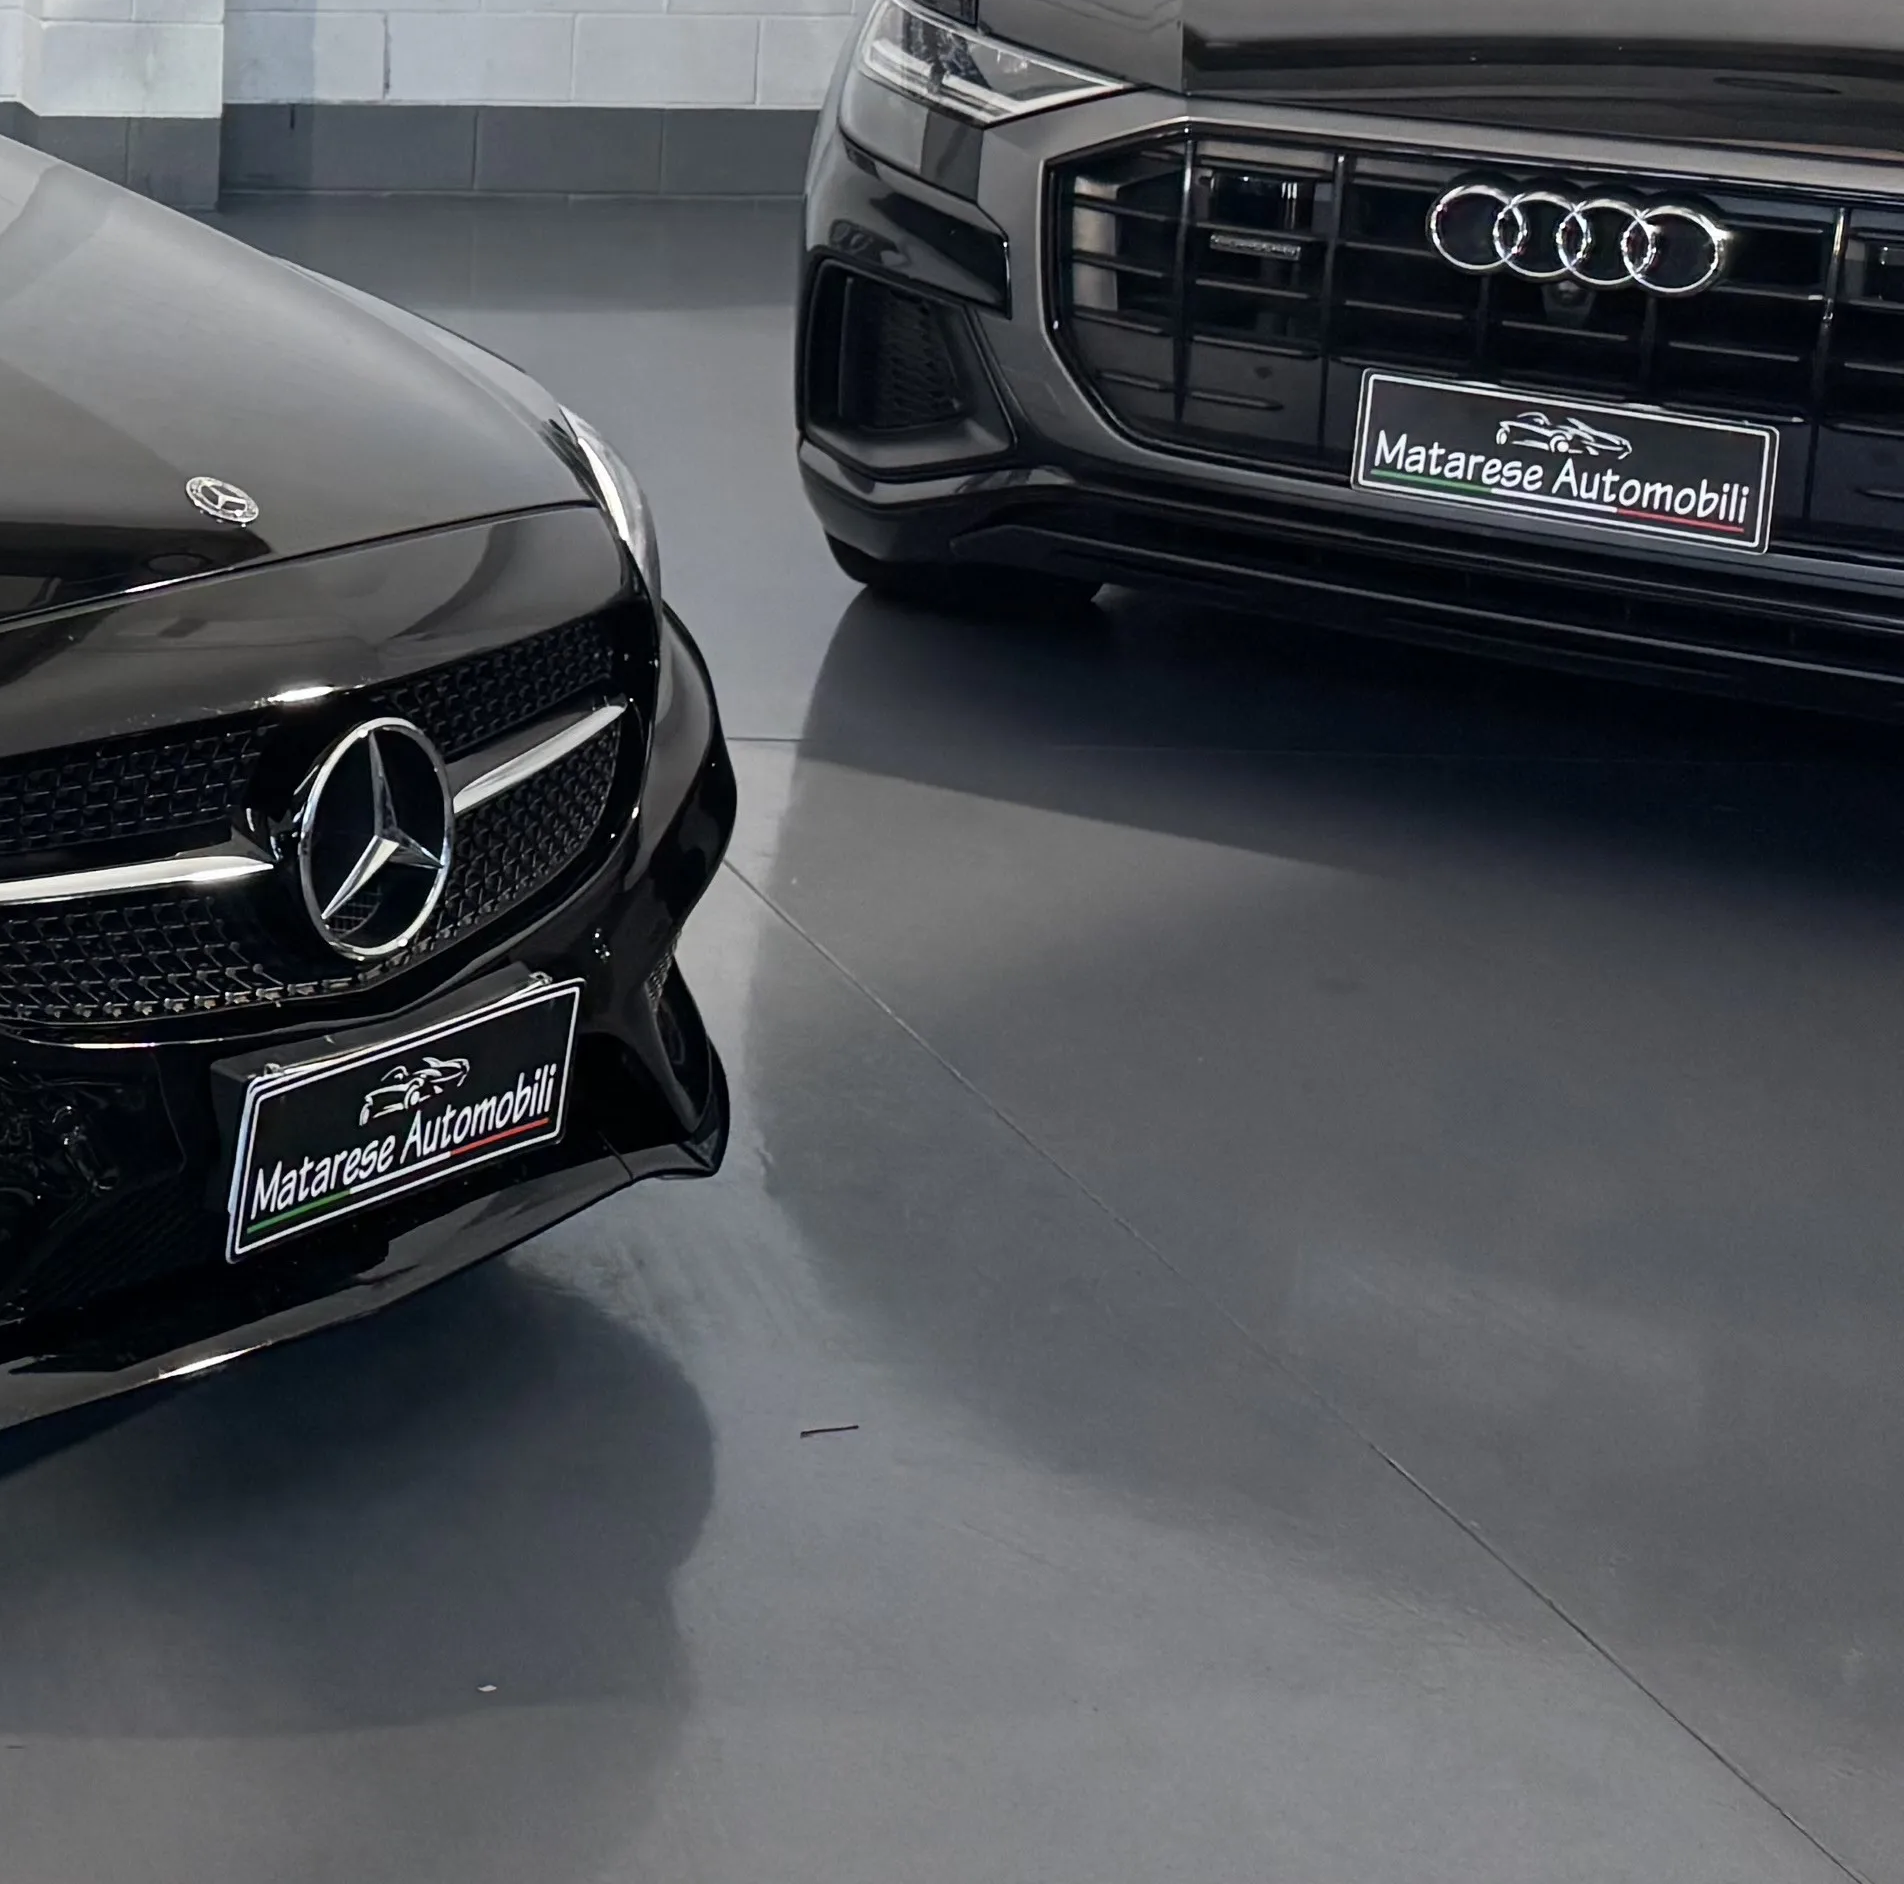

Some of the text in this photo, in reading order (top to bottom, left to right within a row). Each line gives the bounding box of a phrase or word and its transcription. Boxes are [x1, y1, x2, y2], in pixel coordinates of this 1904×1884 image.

[1373, 428, 1749, 524] Matarese Automobili
[250, 1063, 557, 1220] Matarese Automobili
